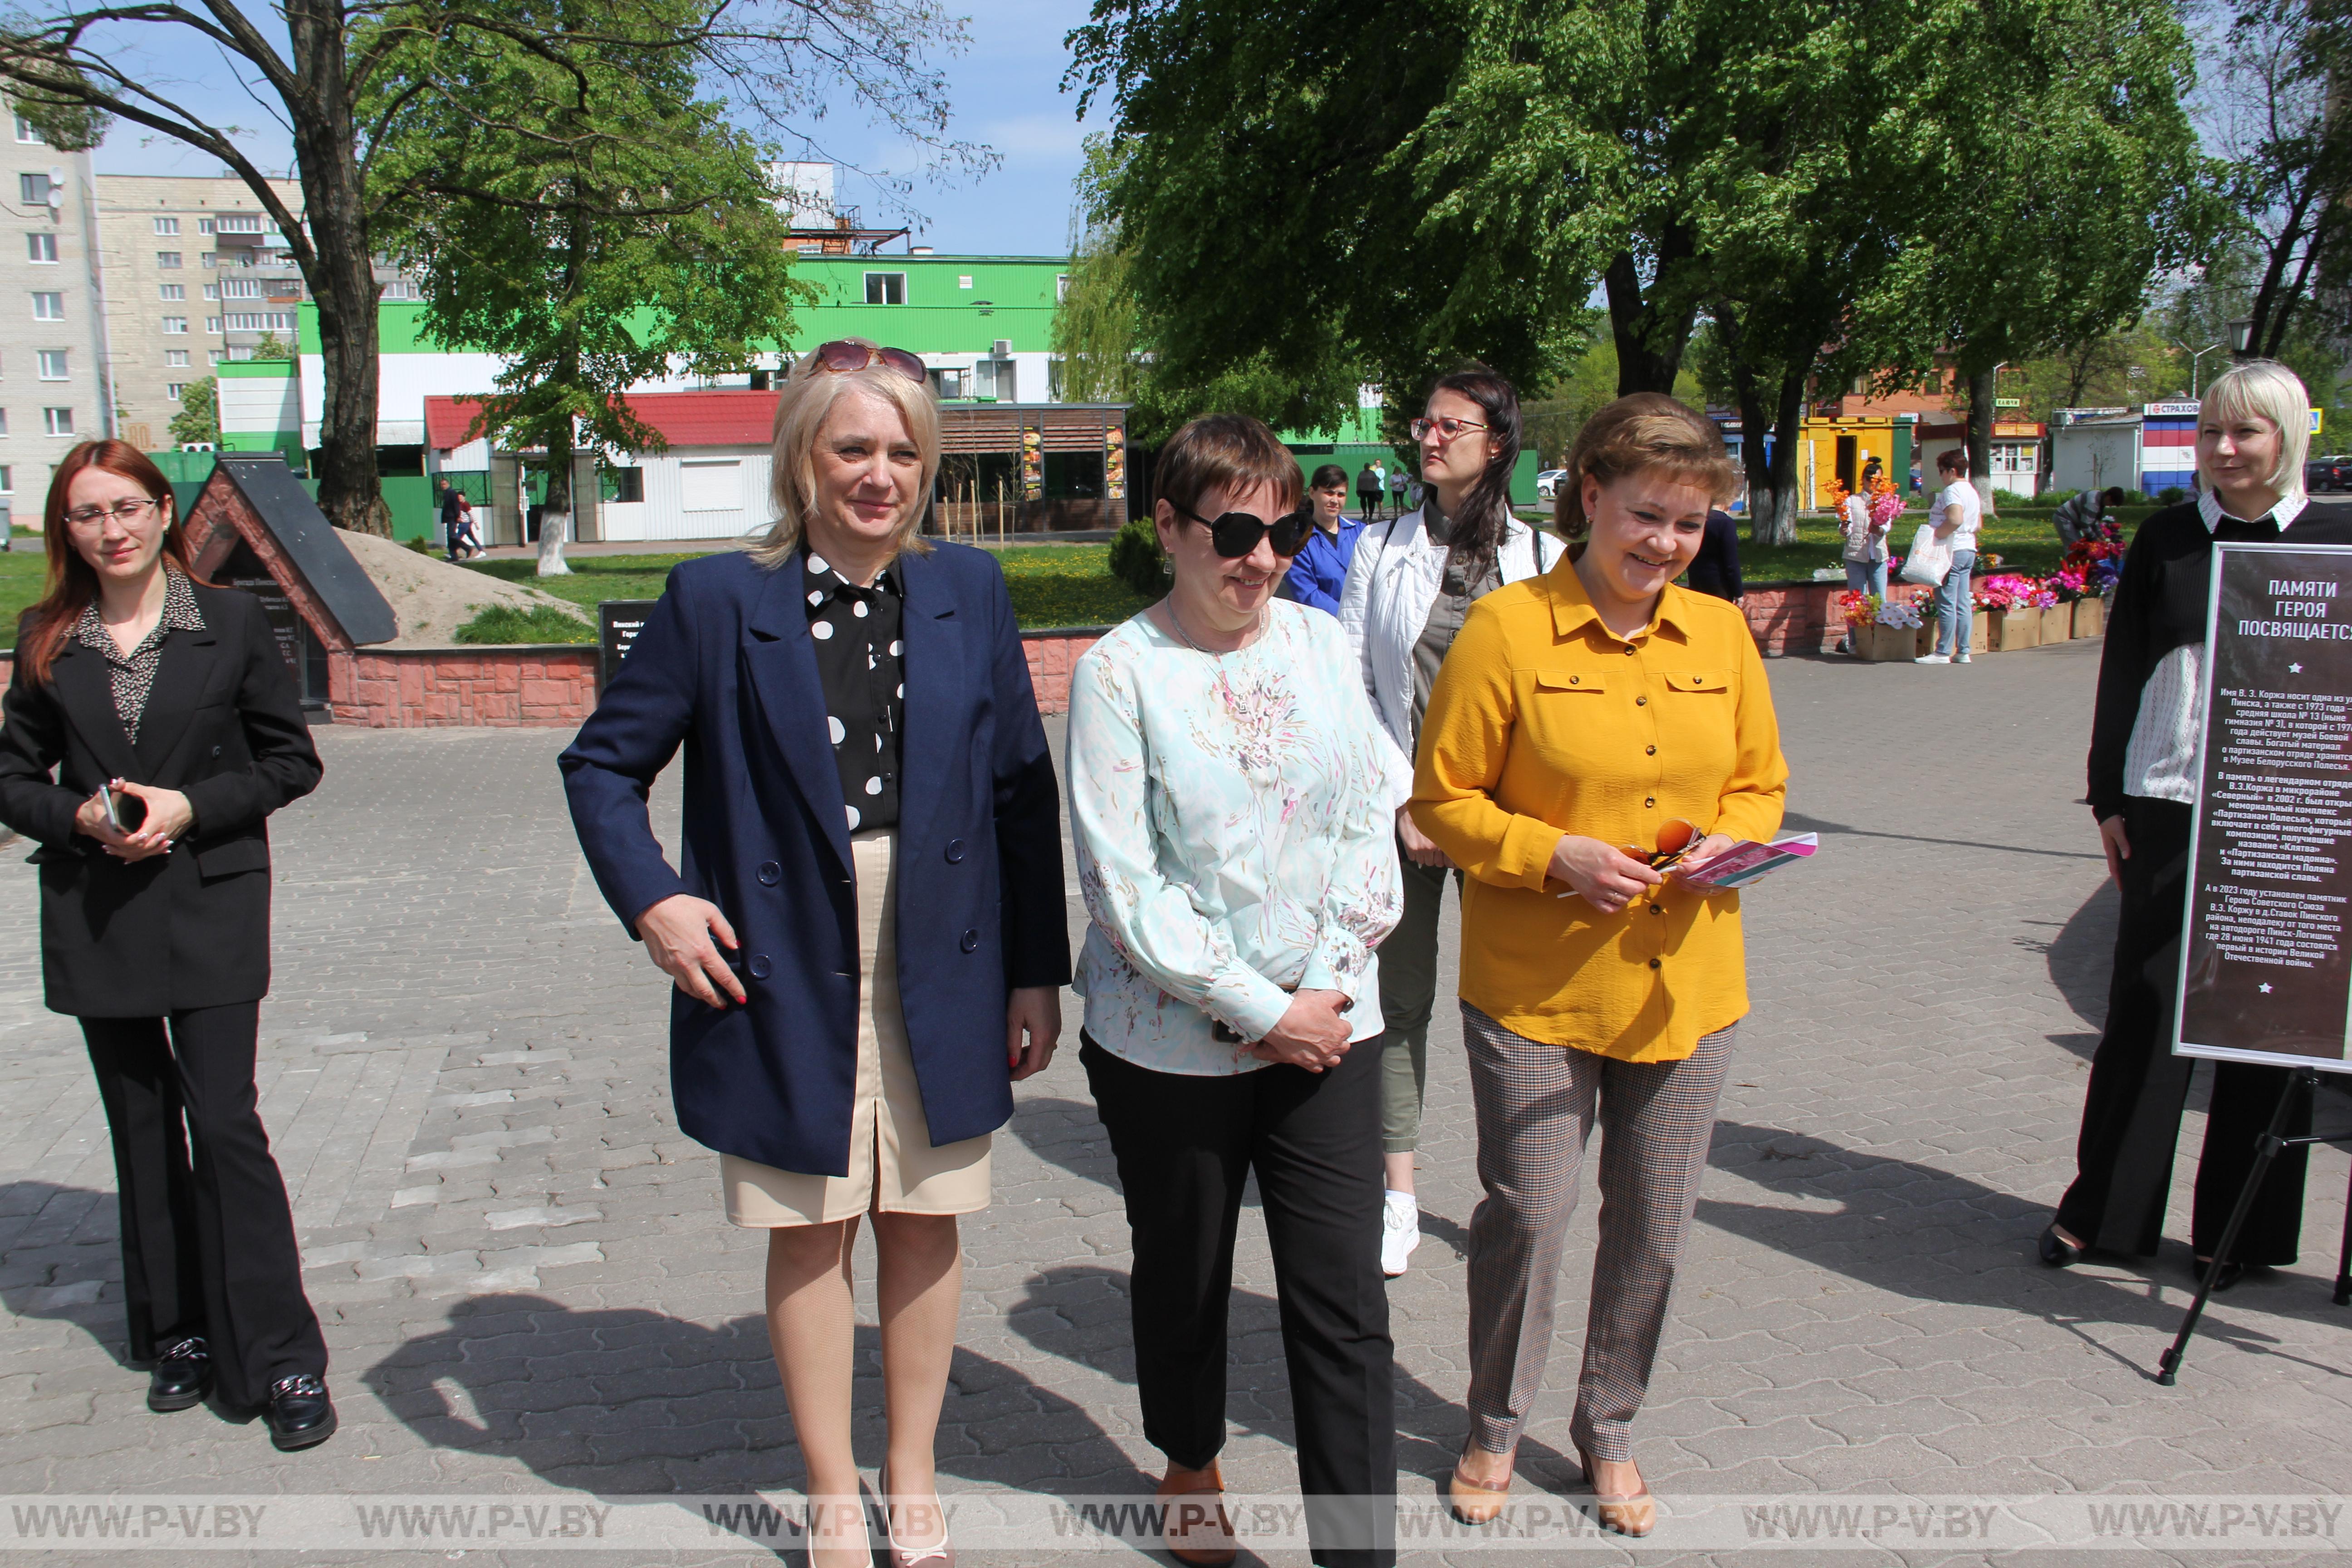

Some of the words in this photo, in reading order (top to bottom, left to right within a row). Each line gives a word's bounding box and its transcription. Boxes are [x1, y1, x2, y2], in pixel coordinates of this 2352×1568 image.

[2269, 580, 2336, 597] ПАМЯТИ
[2275, 601, 2326, 617] ГЕРОЯ
[2259, 690, 2285, 700] Коржа
[2231, 698, 2262, 708] Пинска,
[2306, 702, 2323, 710] 1973
[2327, 704, 2345, 713] года
[2271, 710, 2296, 719] школа
[2322, 713, 2346, 721] (ныне
[2276, 720, 2285, 729] 3),
[2295, 721, 2327, 731] которой
[2250, 729, 2290, 739] действует
[2319, 732, 2348, 741] Боевой
[2266, 738, 2299, 747] Богатый
[2302, 743, 2340, 751] материал
[2229, 748, 2284, 756] партизанском
[2317, 752, 2352, 760] хранится
[2230, 755, 2254, 765] Музее
[2257, 757, 2312, 768] Белорусского
[2314, 760, 2350, 770] Полесья.
[2264, 777, 2321, 786] легендарном
[2323, 779, 2352, 789] отряде
[2283, 785, 2340, 796] микрорайоне
[2212, 791, 2263, 800] «Северный»
[2275, 794, 2294, 803] 2002
[2306, 797, 2322, 805] был
[2229, 801, 2293, 812] мемориальный
[2295, 806, 2337, 815] комплекс
[2213, 809, 2267, 819] «Партизанам
[2270, 813, 2312, 823] Полесья»,
[2315, 818, 2352, 827] который
[2226, 831, 2278, 841] композиции,
[2282, 834, 2335, 844] получившие
[2282, 825, 2352, 836] многофигурные
[2238, 841, 2277, 849] название
[2280, 843, 2319, 852] «Клятва»
[2227, 848, 2290, 860] «Партизанская
[2293, 853, 2337, 864] мадонна».
[2257, 862, 2300, 870] находится
[2303, 864, 2334, 873] Поляна
[2231, 868, 2289, 879] партизанской
[2291, 874, 2322, 882] славы.
[2220, 885, 2238, 894] 2023
[2240, 888, 2258, 897] году
[2259, 890, 2305, 899] установлен
[2307, 894, 2347, 903] памятник
[2225, 895, 2249, 905] Герою
[2252, 897, 2295, 908] Советского
[2298, 901, 2324, 911] Союза
[2205, 913, 2235, 923] района,
[2239, 917, 2285, 927] неподалеку
[2228, 905, 2253, 916] Коржу
[2300, 911, 2338, 921] Пинского
[2221, 925, 2264, 935] автодороге
[2267, 927, 2335, 941] Пинск-Логишин,
[2256, 936, 2273, 944] 1941
[2297, 941, 2337, 950] состоялся
[2216, 942, 2246, 951] первый
[2256, 947, 2287, 956] истории
[2290, 948, 2325, 959] Великой
[2225, 952, 2283, 965] Отечественной
[2285, 959, 2314, 967] войны.
